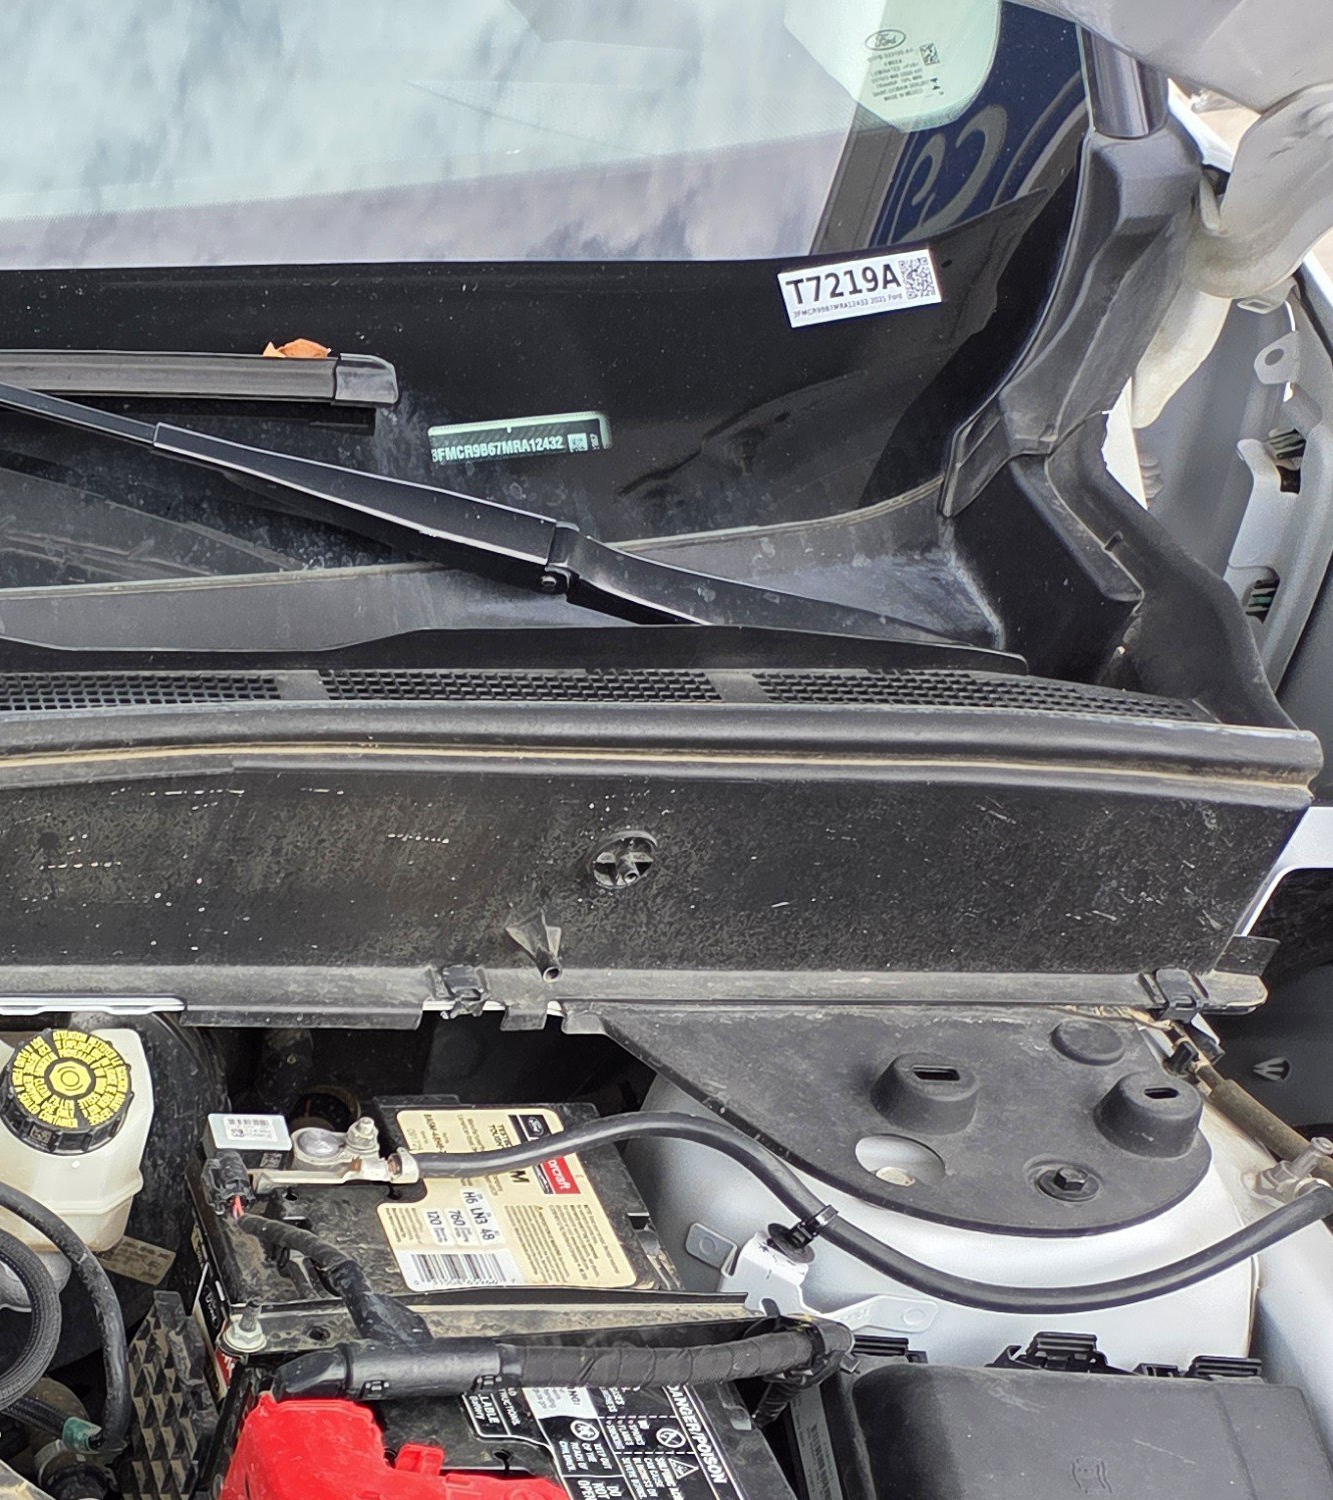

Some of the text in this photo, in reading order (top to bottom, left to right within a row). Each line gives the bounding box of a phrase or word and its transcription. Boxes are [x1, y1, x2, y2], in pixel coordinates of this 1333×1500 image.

[785, 263, 902, 304] T7219A
[431, 435, 564, 463] 3FMCR9B67MRA12432
[545, 1157, 573, 1192] orcraft
[593, 1482, 609, 1498] NOT
[607, 1485, 621, 1496] DO
